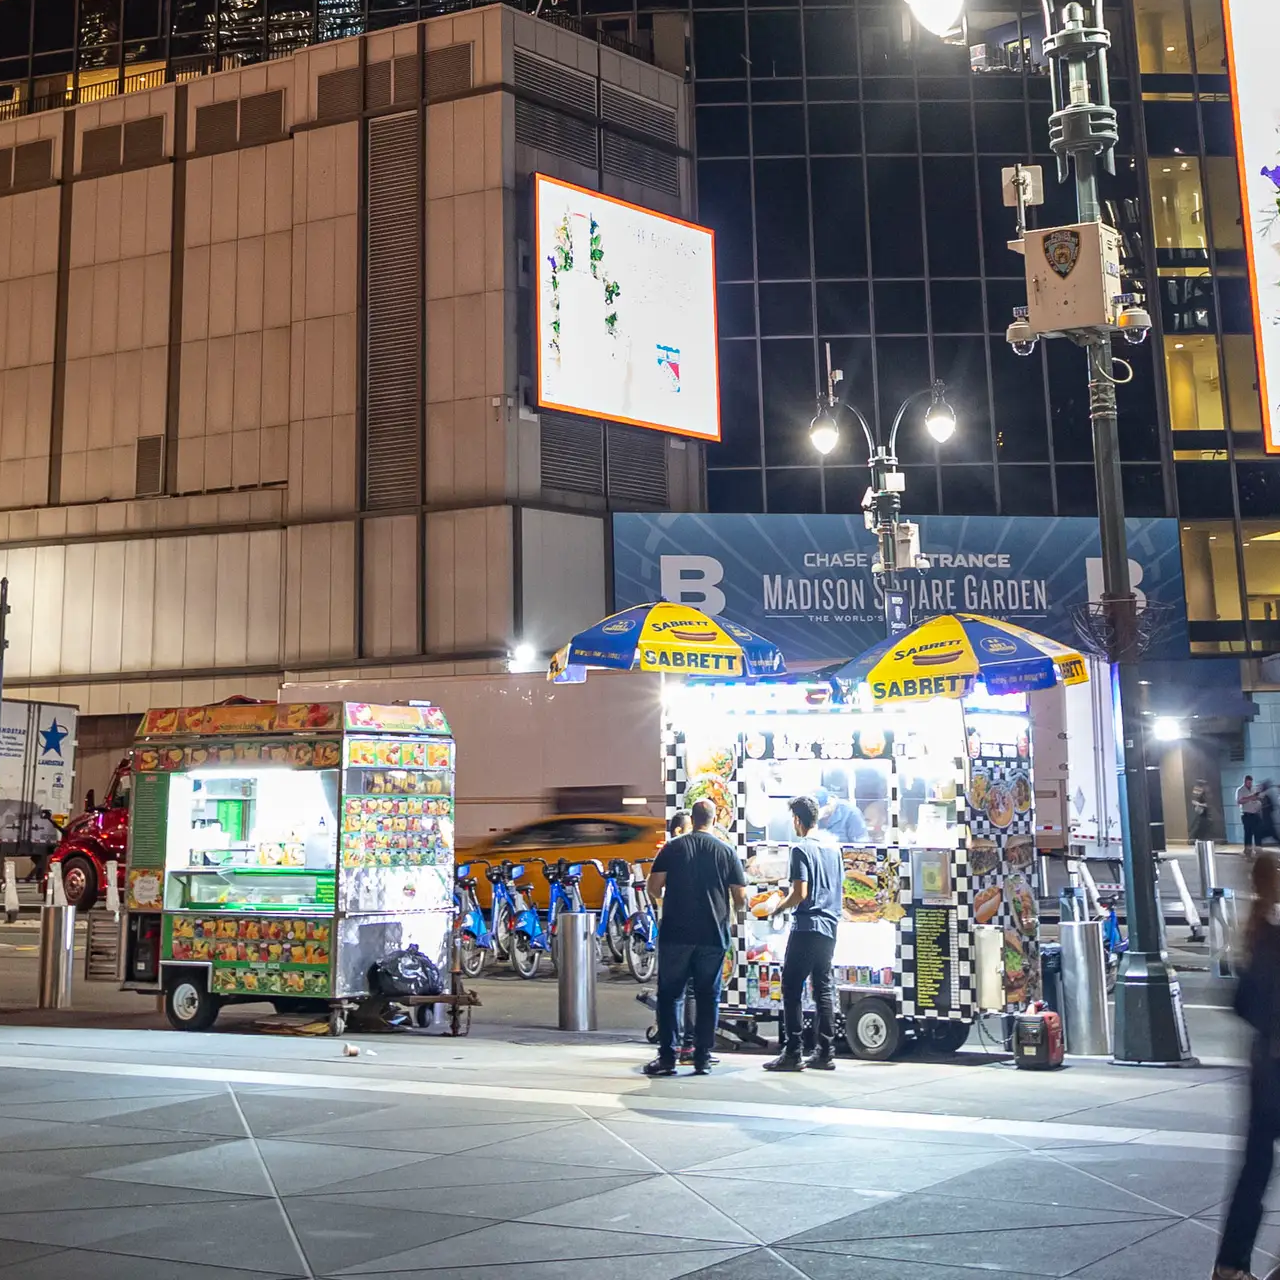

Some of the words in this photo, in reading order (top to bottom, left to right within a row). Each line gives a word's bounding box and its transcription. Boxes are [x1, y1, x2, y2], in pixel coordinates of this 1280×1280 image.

[803, 553, 868, 568] CHASE
[914, 553, 1011, 568] TRANCE
[660, 554, 727, 617] B
[763, 574, 866, 611] MADISON
[872, 576, 957, 611] SUARE
[651, 619, 709, 632] SABRETT
[808, 614, 830, 622] THE
[643, 649, 738, 671] SABRETT
[893, 638, 963, 661] SABRETT
[873, 674, 971, 700] SABRETT
